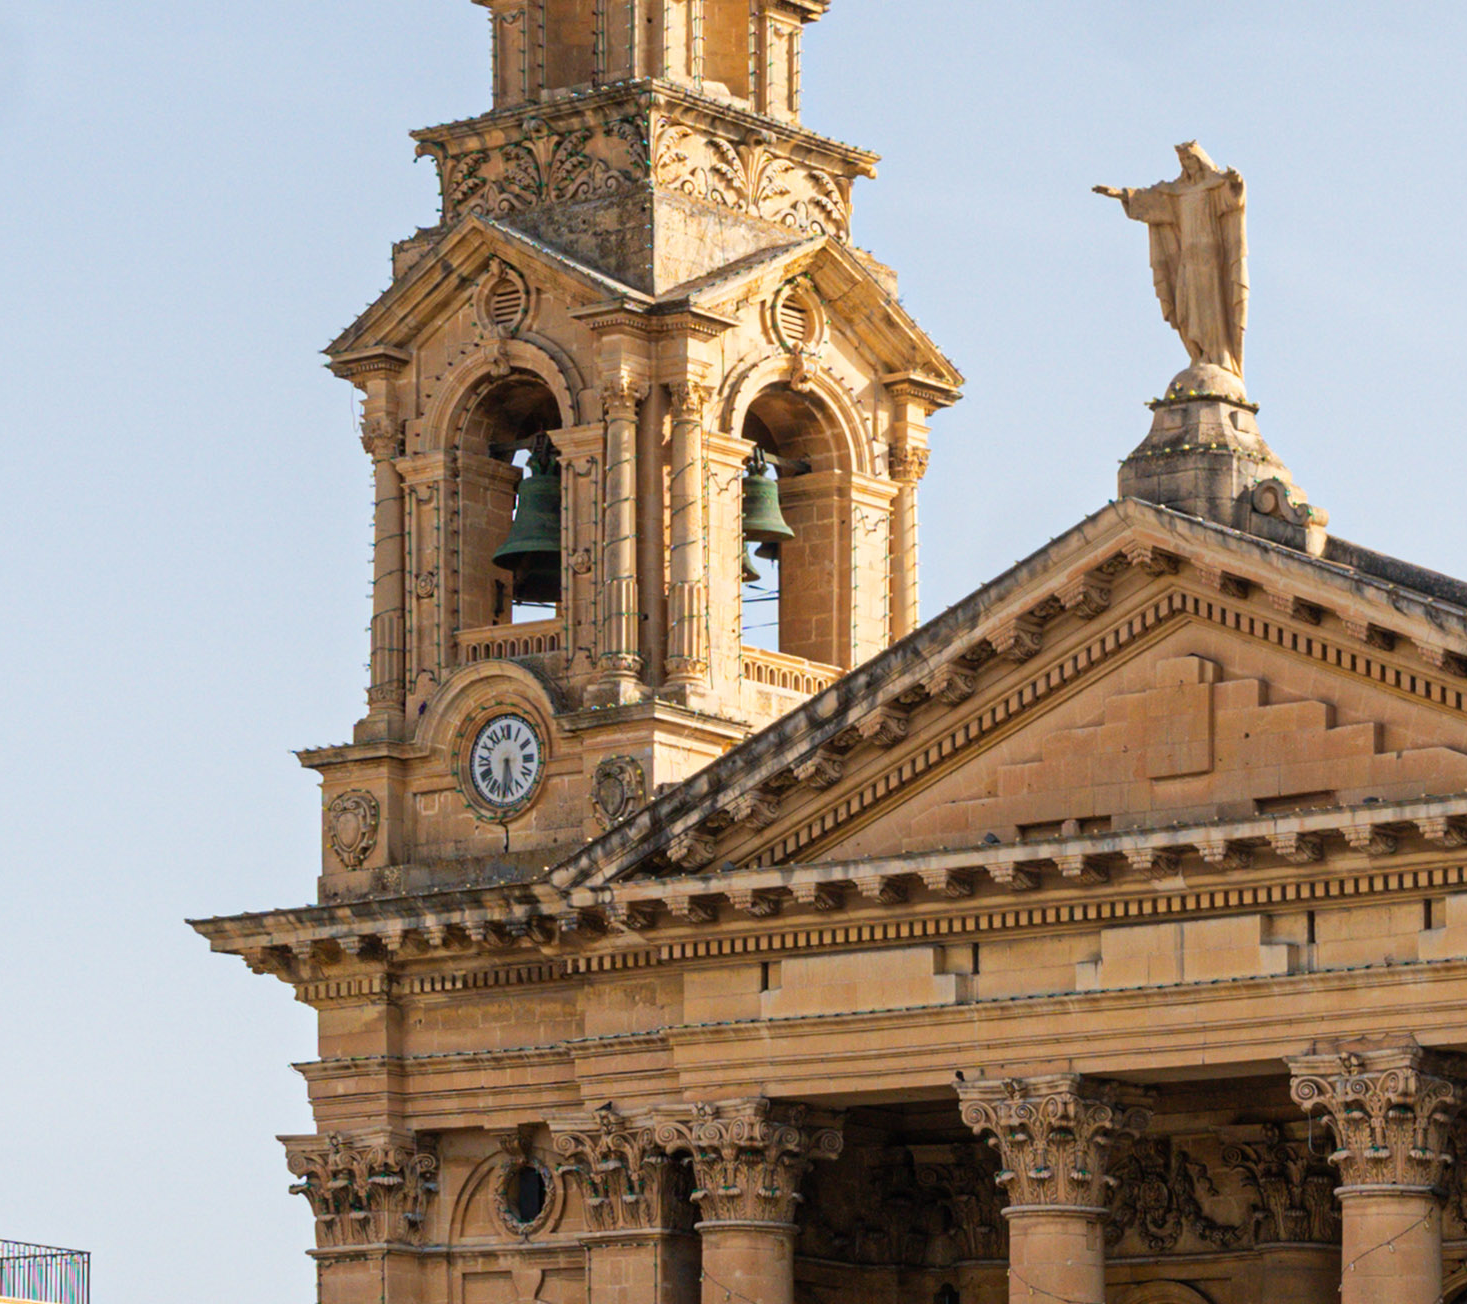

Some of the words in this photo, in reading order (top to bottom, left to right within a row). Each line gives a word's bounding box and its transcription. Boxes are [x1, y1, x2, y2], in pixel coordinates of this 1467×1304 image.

[486, 730, 501, 748] XI
[499, 724, 512, 741] XII
[481, 741, 494, 755] X
[519, 737, 532, 751] II
[478, 754, 491, 767] IX
[522, 753, 534, 763] III
[521, 765, 533, 783] IV
[514, 778, 524, 793] V
